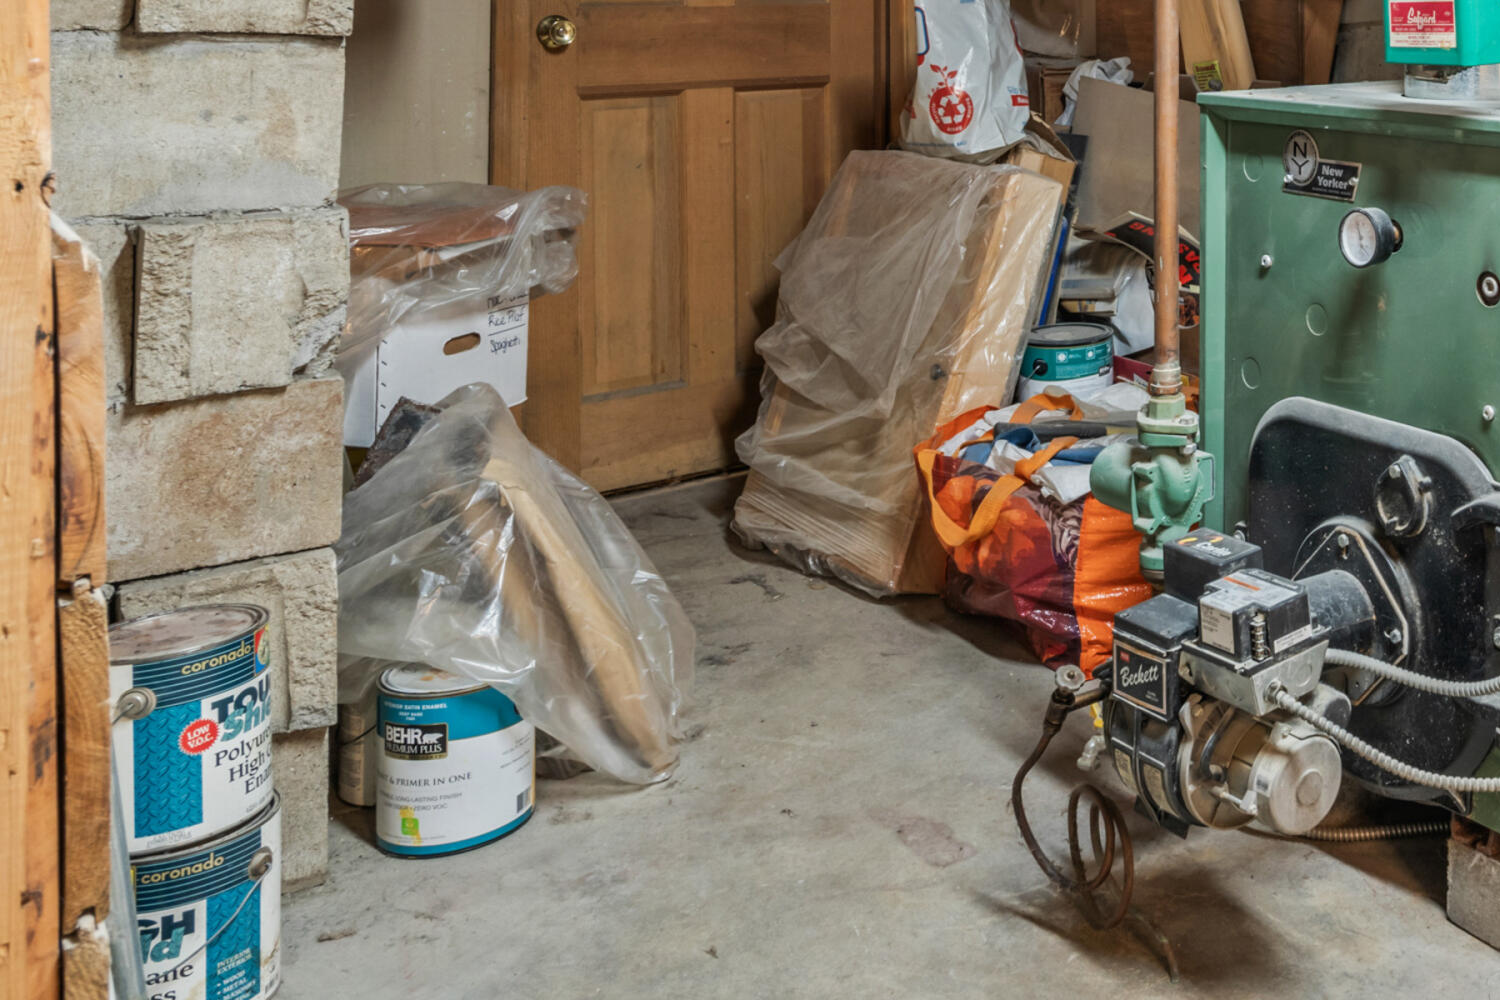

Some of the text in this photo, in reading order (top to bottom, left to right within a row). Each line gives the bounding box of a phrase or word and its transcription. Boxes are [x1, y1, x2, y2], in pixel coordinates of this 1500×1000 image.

[1293, 140, 1308, 159] N
[1291, 157, 1310, 176] Y
[1321, 164, 1344, 178] New
[1317, 175, 1349, 191] Yorker
[181, 640, 252, 675] coronado
[1119, 663, 1160, 688] Beckett
[186, 724, 211, 741] LOW
[187, 734, 214, 749] V.O.C.
[385, 724, 423, 745] BEHR
[385, 743, 442, 754] PREMIUM PLUS
[229, 751, 266, 783] High
[395, 777, 431, 787] PRIMER
[432, 778, 445, 786] IN
[448, 772, 472, 784] ONE
[140, 852, 225, 885] coronado
[222, 977, 248, 995] METAL
